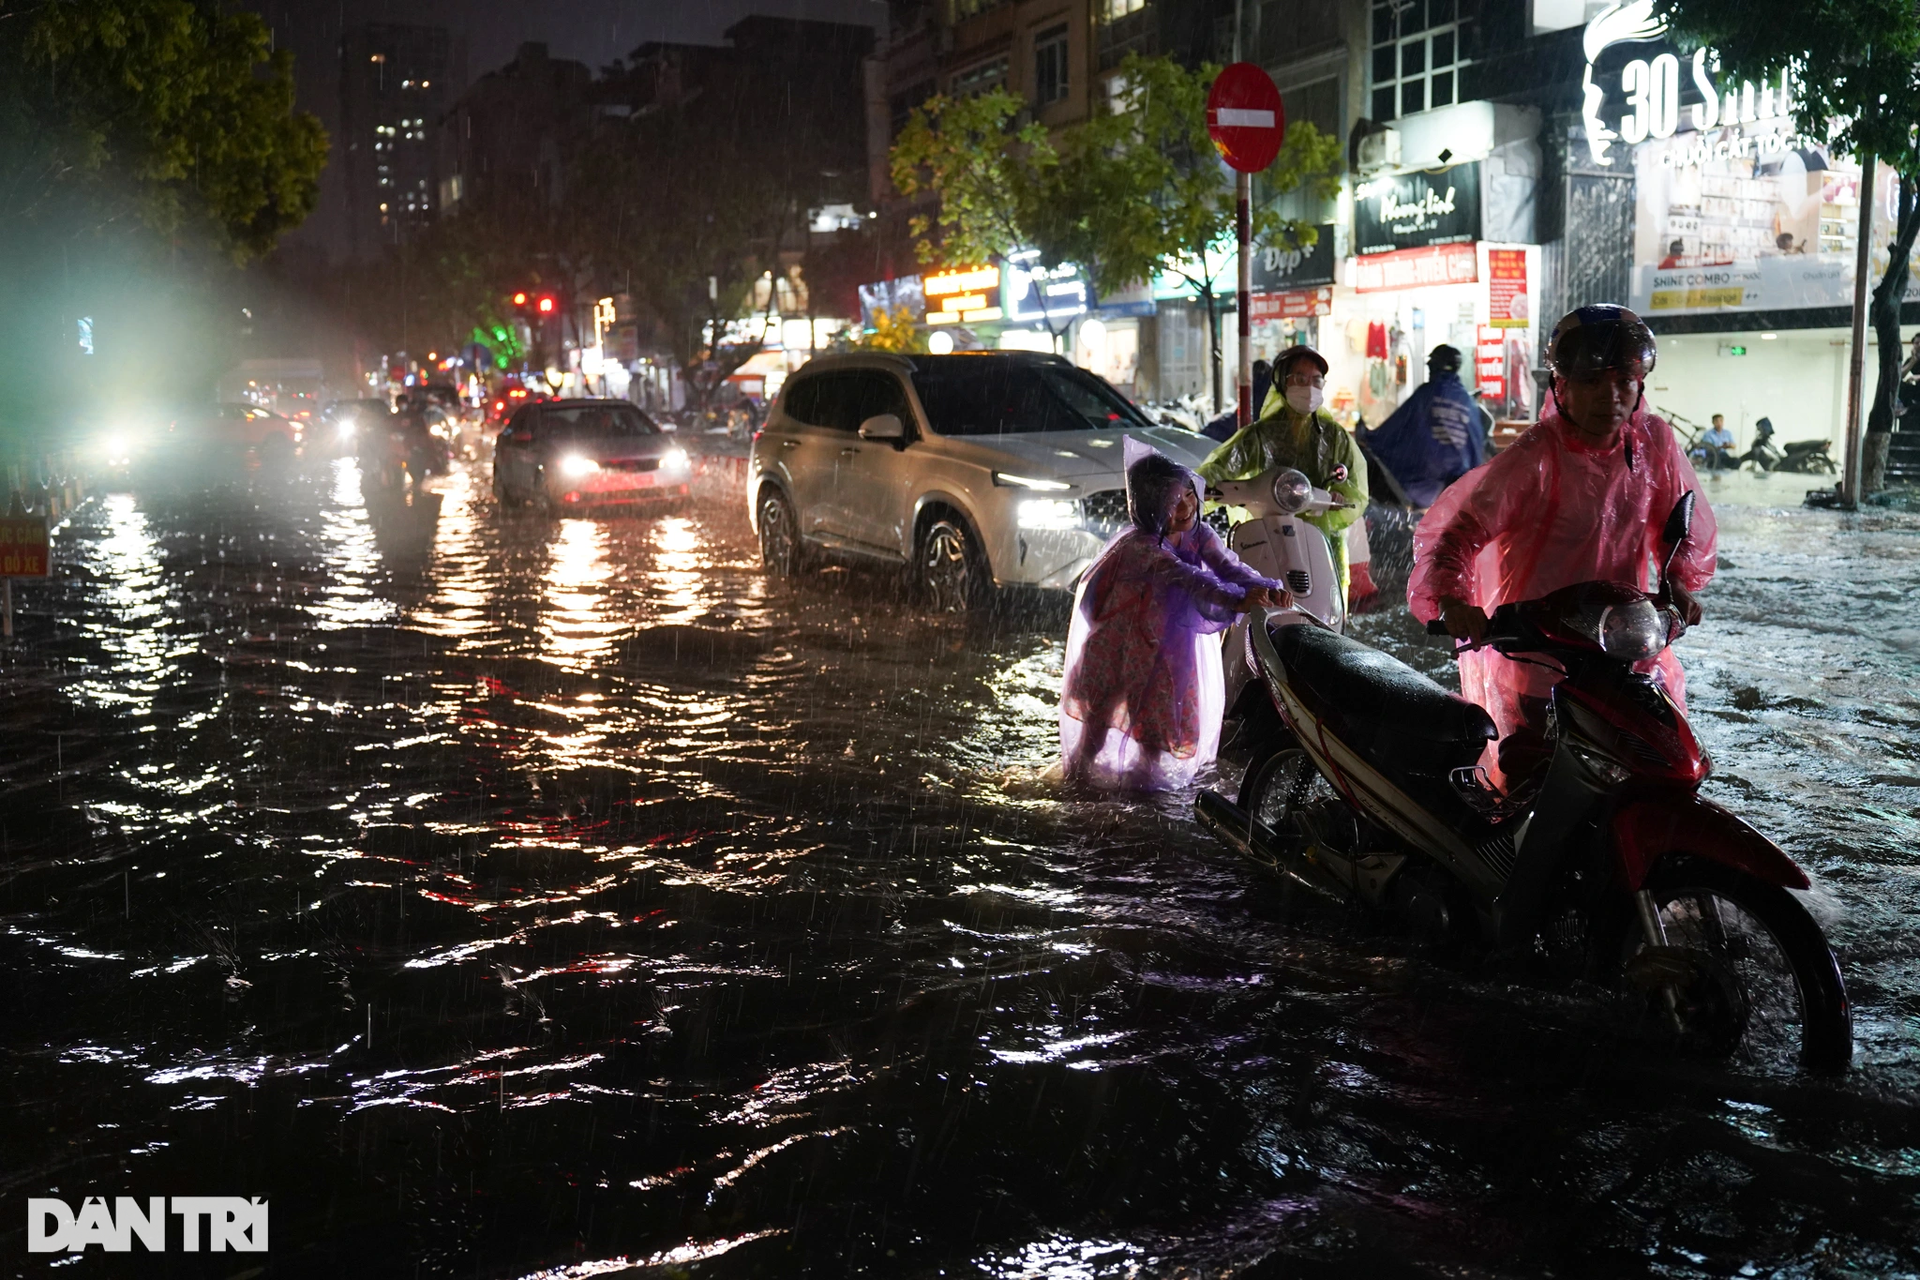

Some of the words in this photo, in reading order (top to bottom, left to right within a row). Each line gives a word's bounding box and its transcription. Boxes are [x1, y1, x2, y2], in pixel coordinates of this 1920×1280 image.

[1620, 52, 1679, 144] 30
[1653, 274, 1685, 288] SHINE
[1686, 272, 1731, 286] COMBO
[24, 556, 39, 573] XE
